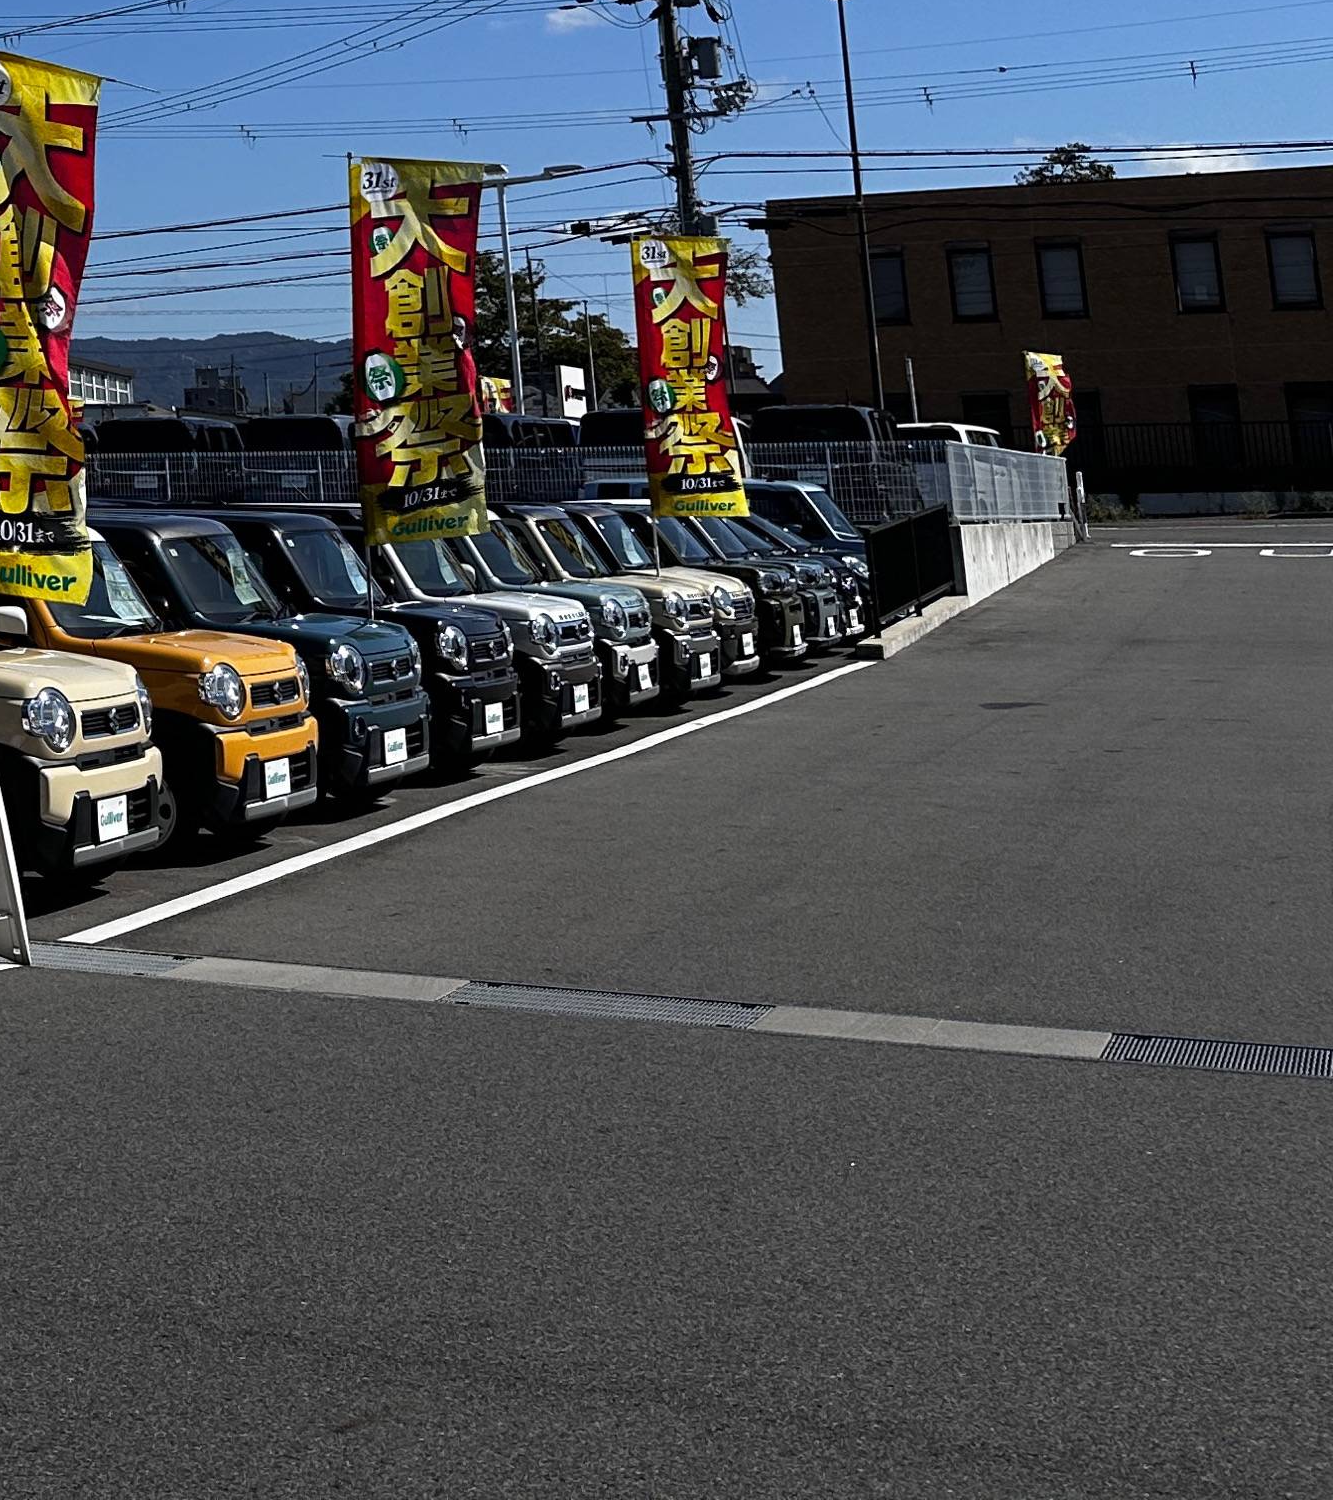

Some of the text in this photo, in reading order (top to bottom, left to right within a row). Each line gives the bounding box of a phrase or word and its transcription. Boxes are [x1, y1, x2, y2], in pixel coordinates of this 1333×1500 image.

[363, 171, 396, 190] 31st
[641, 246, 667, 261] 31st
[355, 174, 483, 487] 大創業祭
[644, 242, 736, 476] 大創業祭
[674, 499, 736, 511] Gulliver
[392, 515, 469, 536] Gulliver
[100, 811, 124, 827] Gulliver
